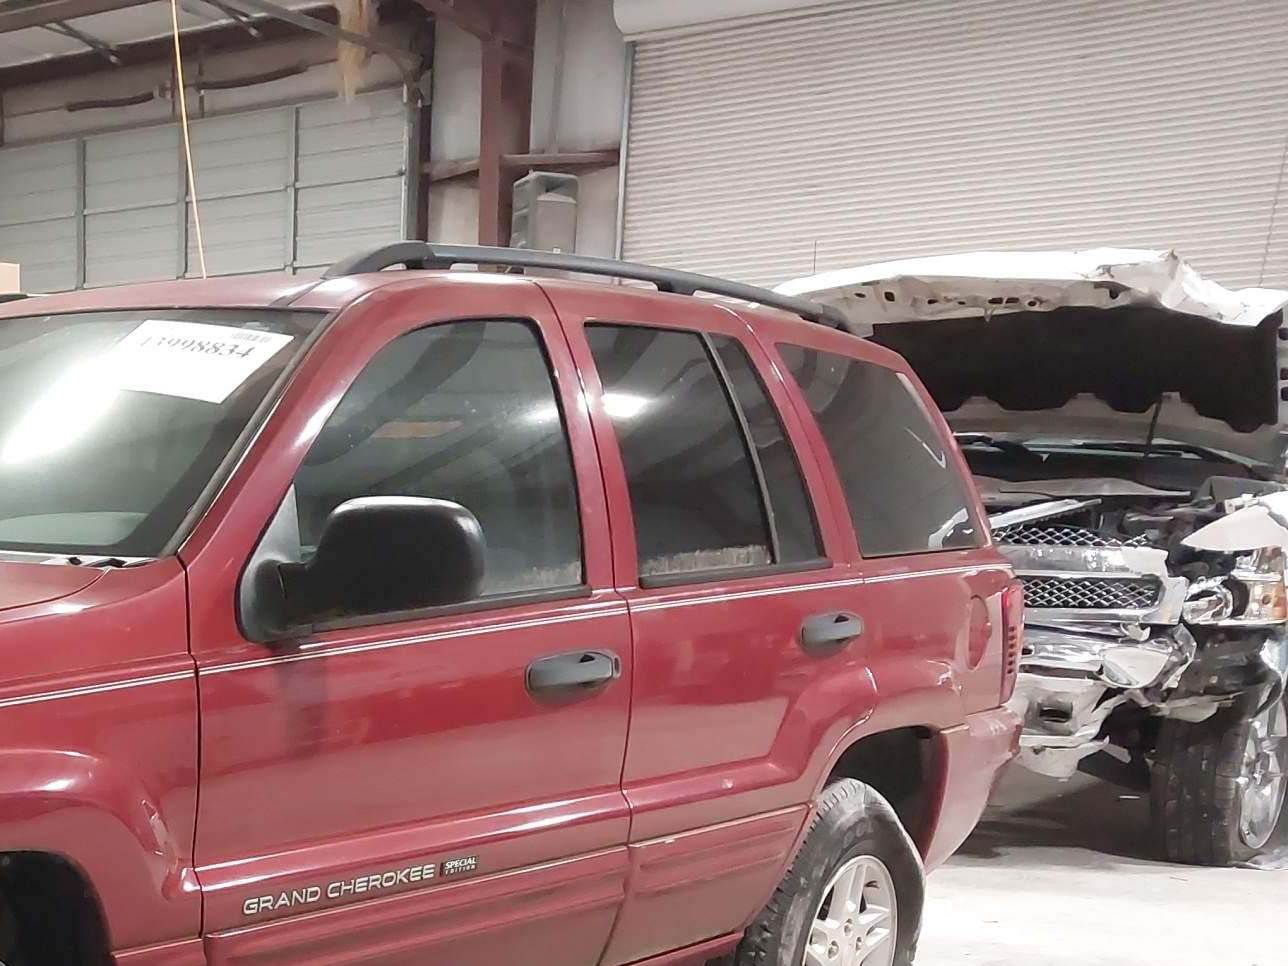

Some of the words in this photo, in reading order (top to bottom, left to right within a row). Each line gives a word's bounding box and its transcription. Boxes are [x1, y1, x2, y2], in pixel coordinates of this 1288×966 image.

[444, 856, 477, 870] SPECIAL
[243, 887, 321, 915] GRAND
[327, 863, 436, 898] CHEROKEE
